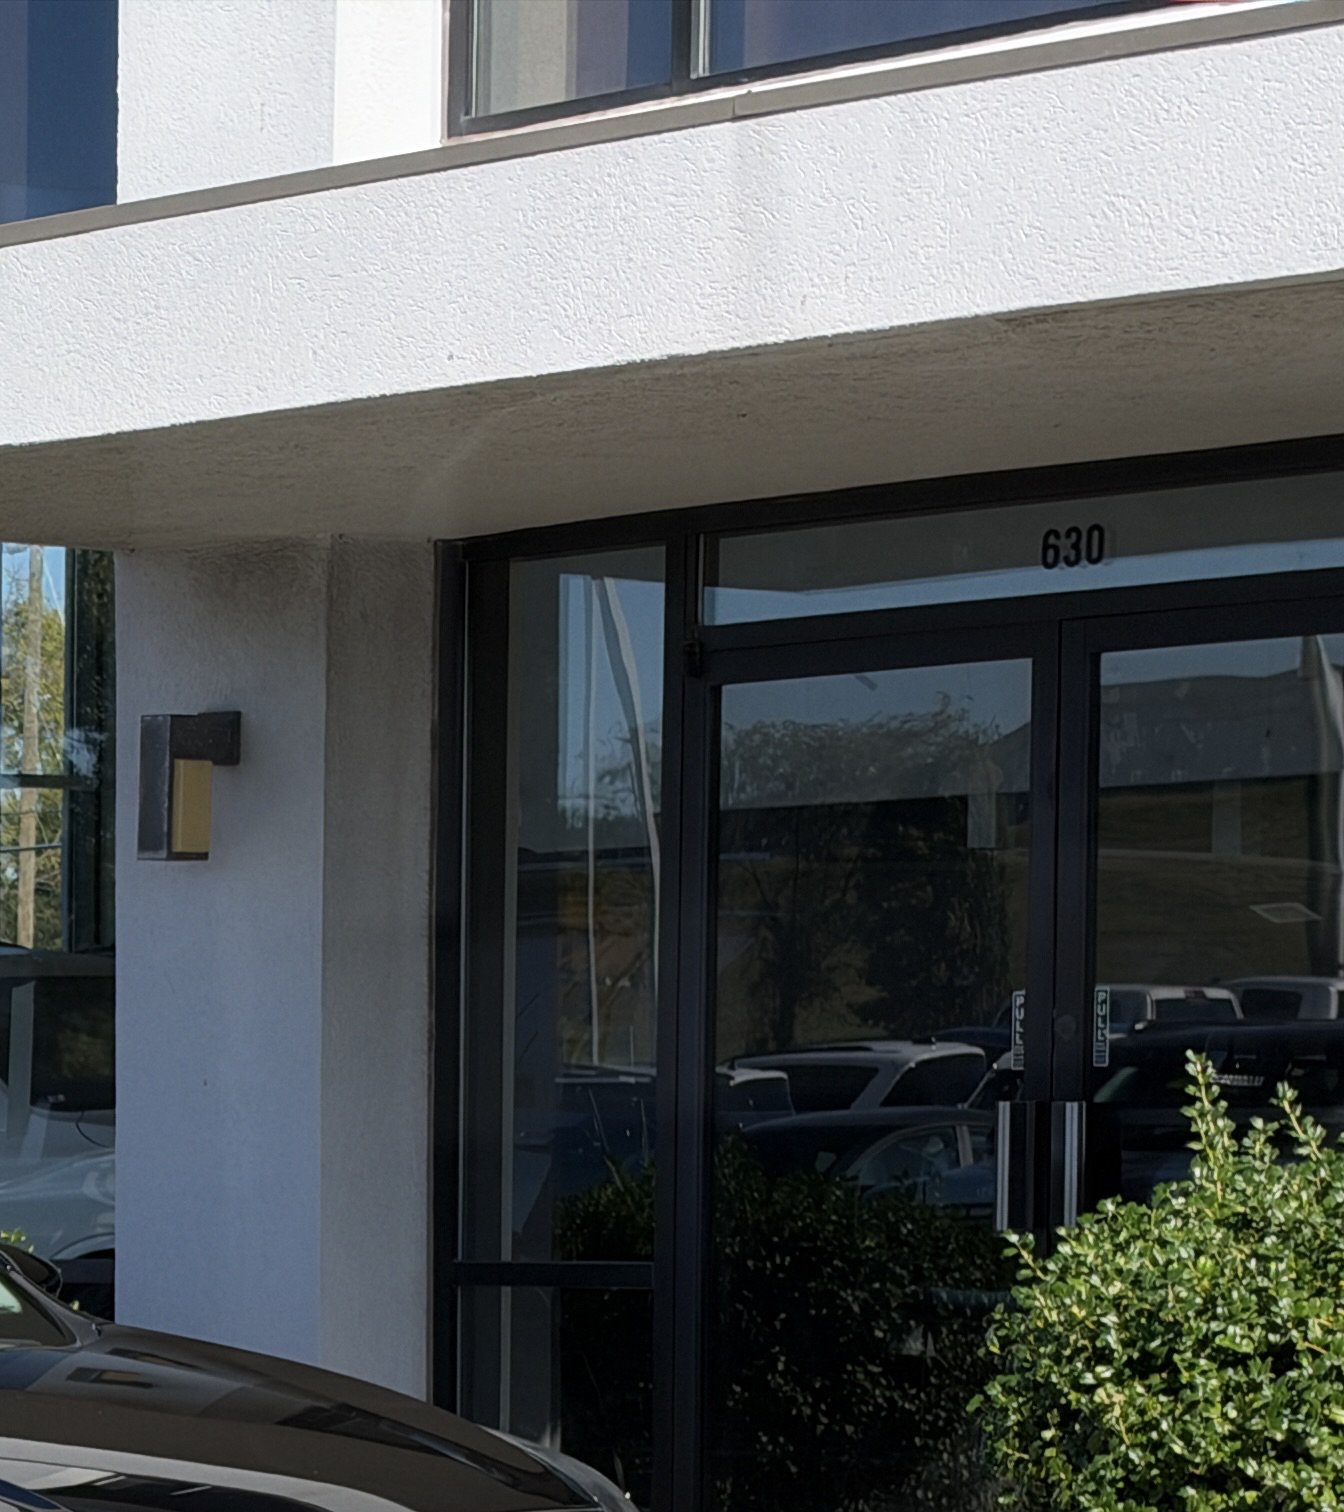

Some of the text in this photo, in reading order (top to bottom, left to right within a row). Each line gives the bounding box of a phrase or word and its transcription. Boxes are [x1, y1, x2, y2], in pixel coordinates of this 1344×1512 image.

[1041, 523, 1104, 569] 630
[1015, 995, 1025, 1045] PULL
[1097, 991, 1107, 1041] PULL
